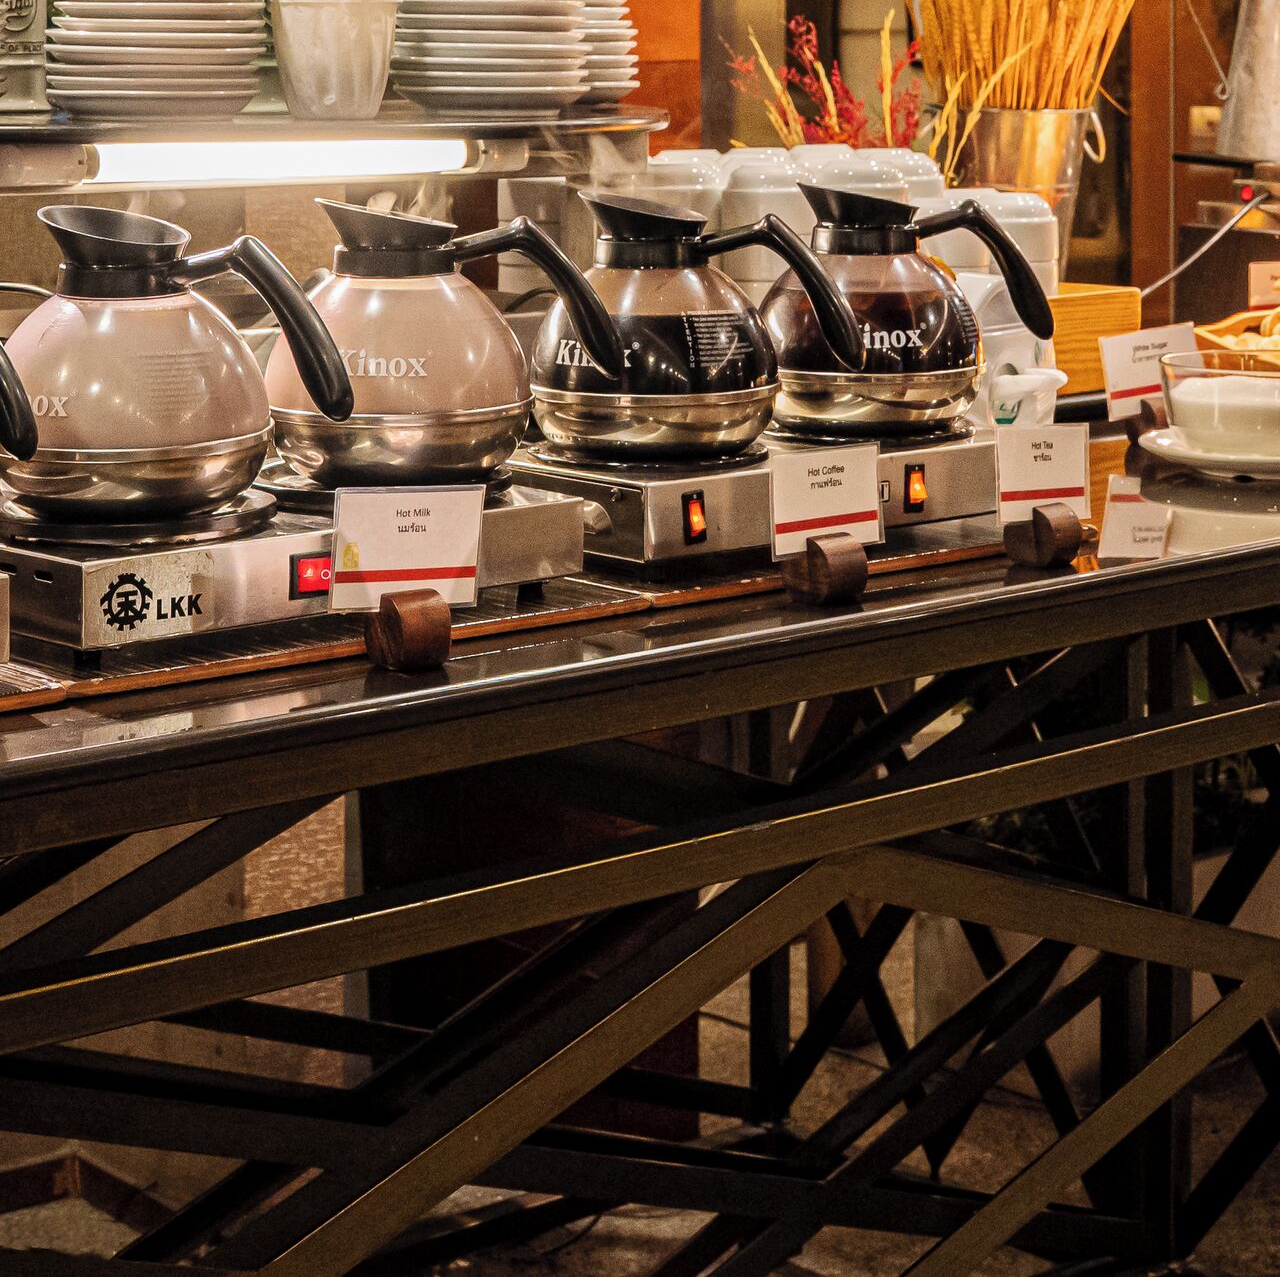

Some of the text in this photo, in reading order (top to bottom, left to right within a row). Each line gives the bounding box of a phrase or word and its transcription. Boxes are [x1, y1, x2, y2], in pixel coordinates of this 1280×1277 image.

[860, 322, 923, 349] inox
[1031, 440, 1054, 450] Hot Tea
[807, 464, 845, 477] Hot Coffee
[396, 507, 431, 518] Hot Milk
[397, 522, 427, 534] นมร้อน
[156, 593, 203, 621] LKK
